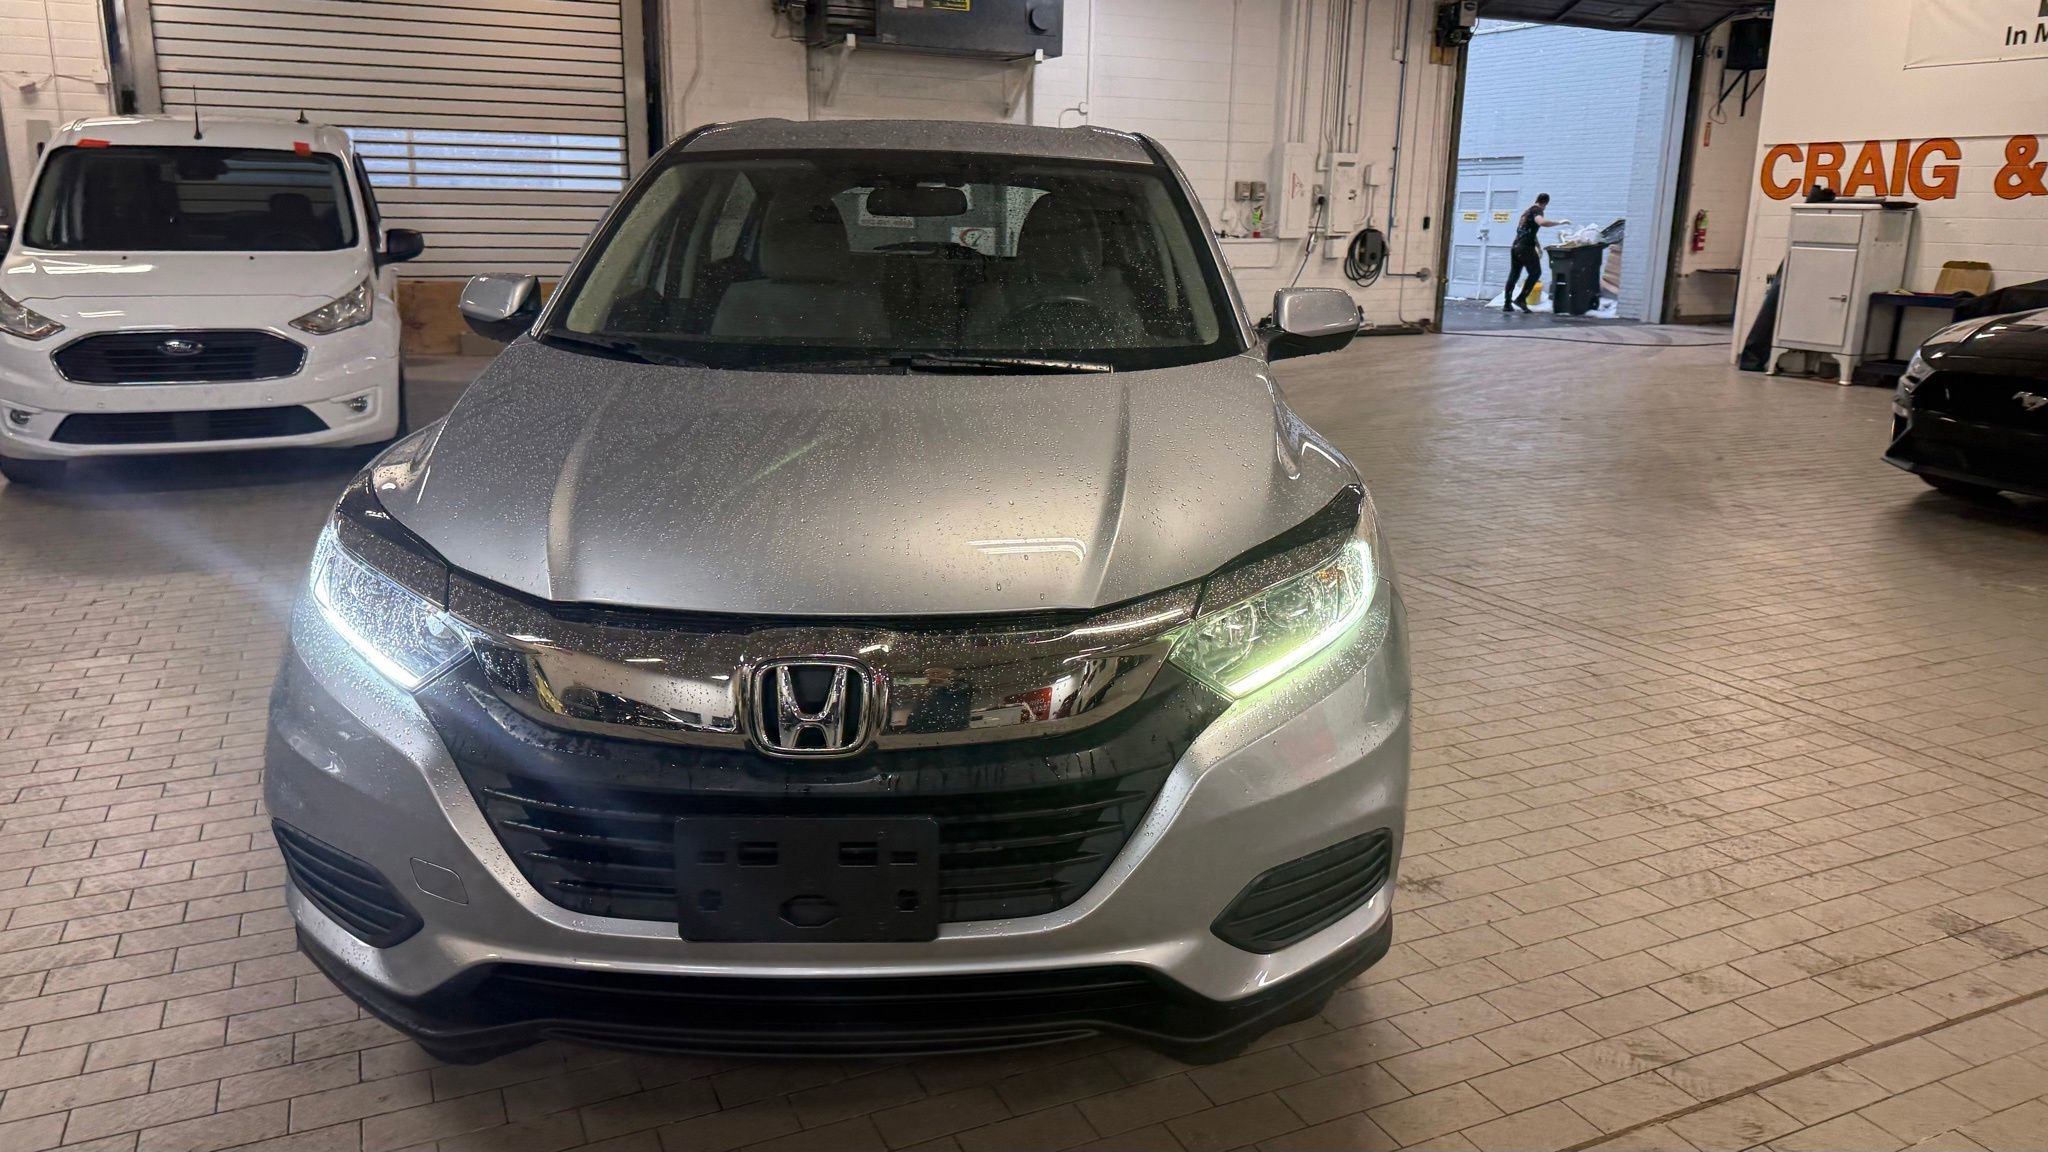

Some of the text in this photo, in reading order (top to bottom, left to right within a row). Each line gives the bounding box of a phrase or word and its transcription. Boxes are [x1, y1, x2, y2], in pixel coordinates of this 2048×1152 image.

[2005, 25, 2027, 46] In
[1760, 134, 2048, 200] CRAIG &
